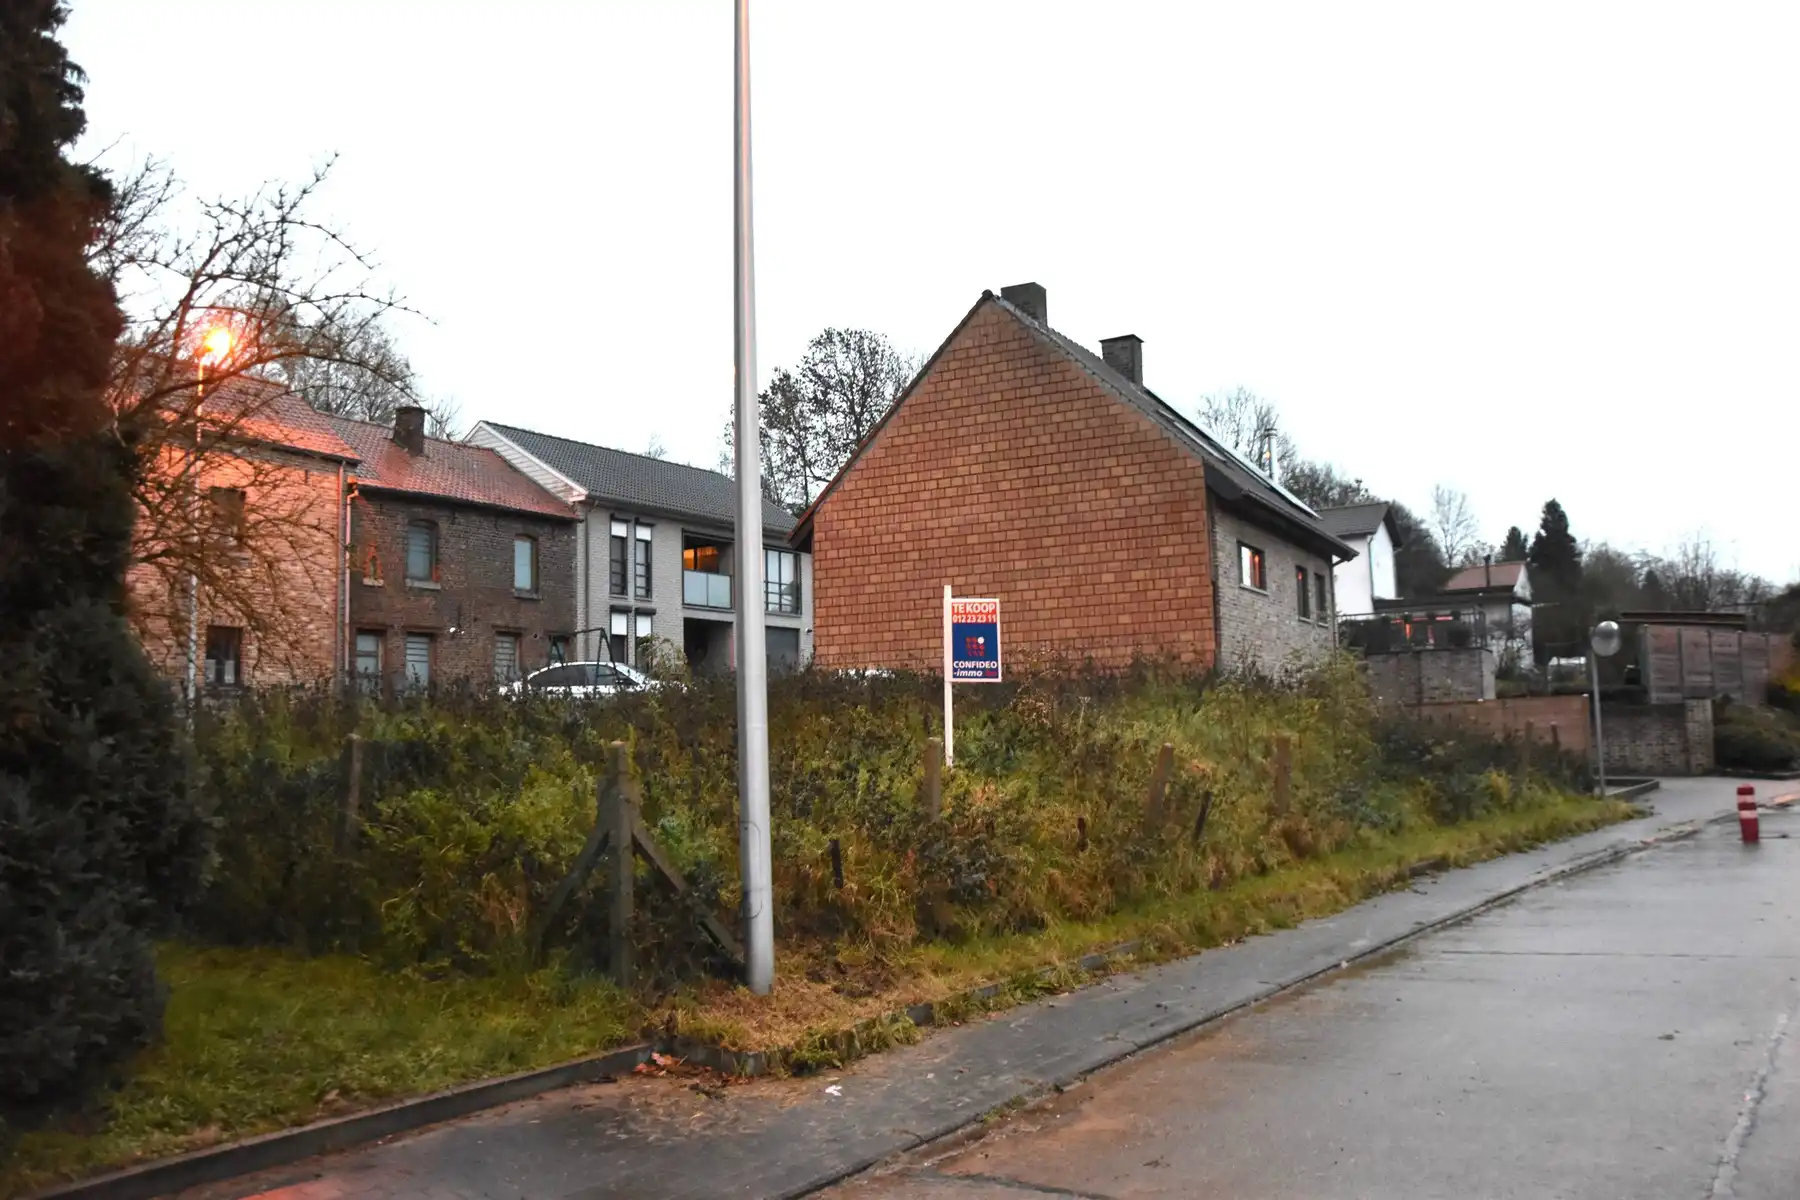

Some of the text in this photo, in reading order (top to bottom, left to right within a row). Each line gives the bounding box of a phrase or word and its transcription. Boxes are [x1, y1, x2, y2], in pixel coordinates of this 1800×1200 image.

[952, 604, 996, 613] TE KOOP
[952, 614, 996, 623] 012 23 23 11
